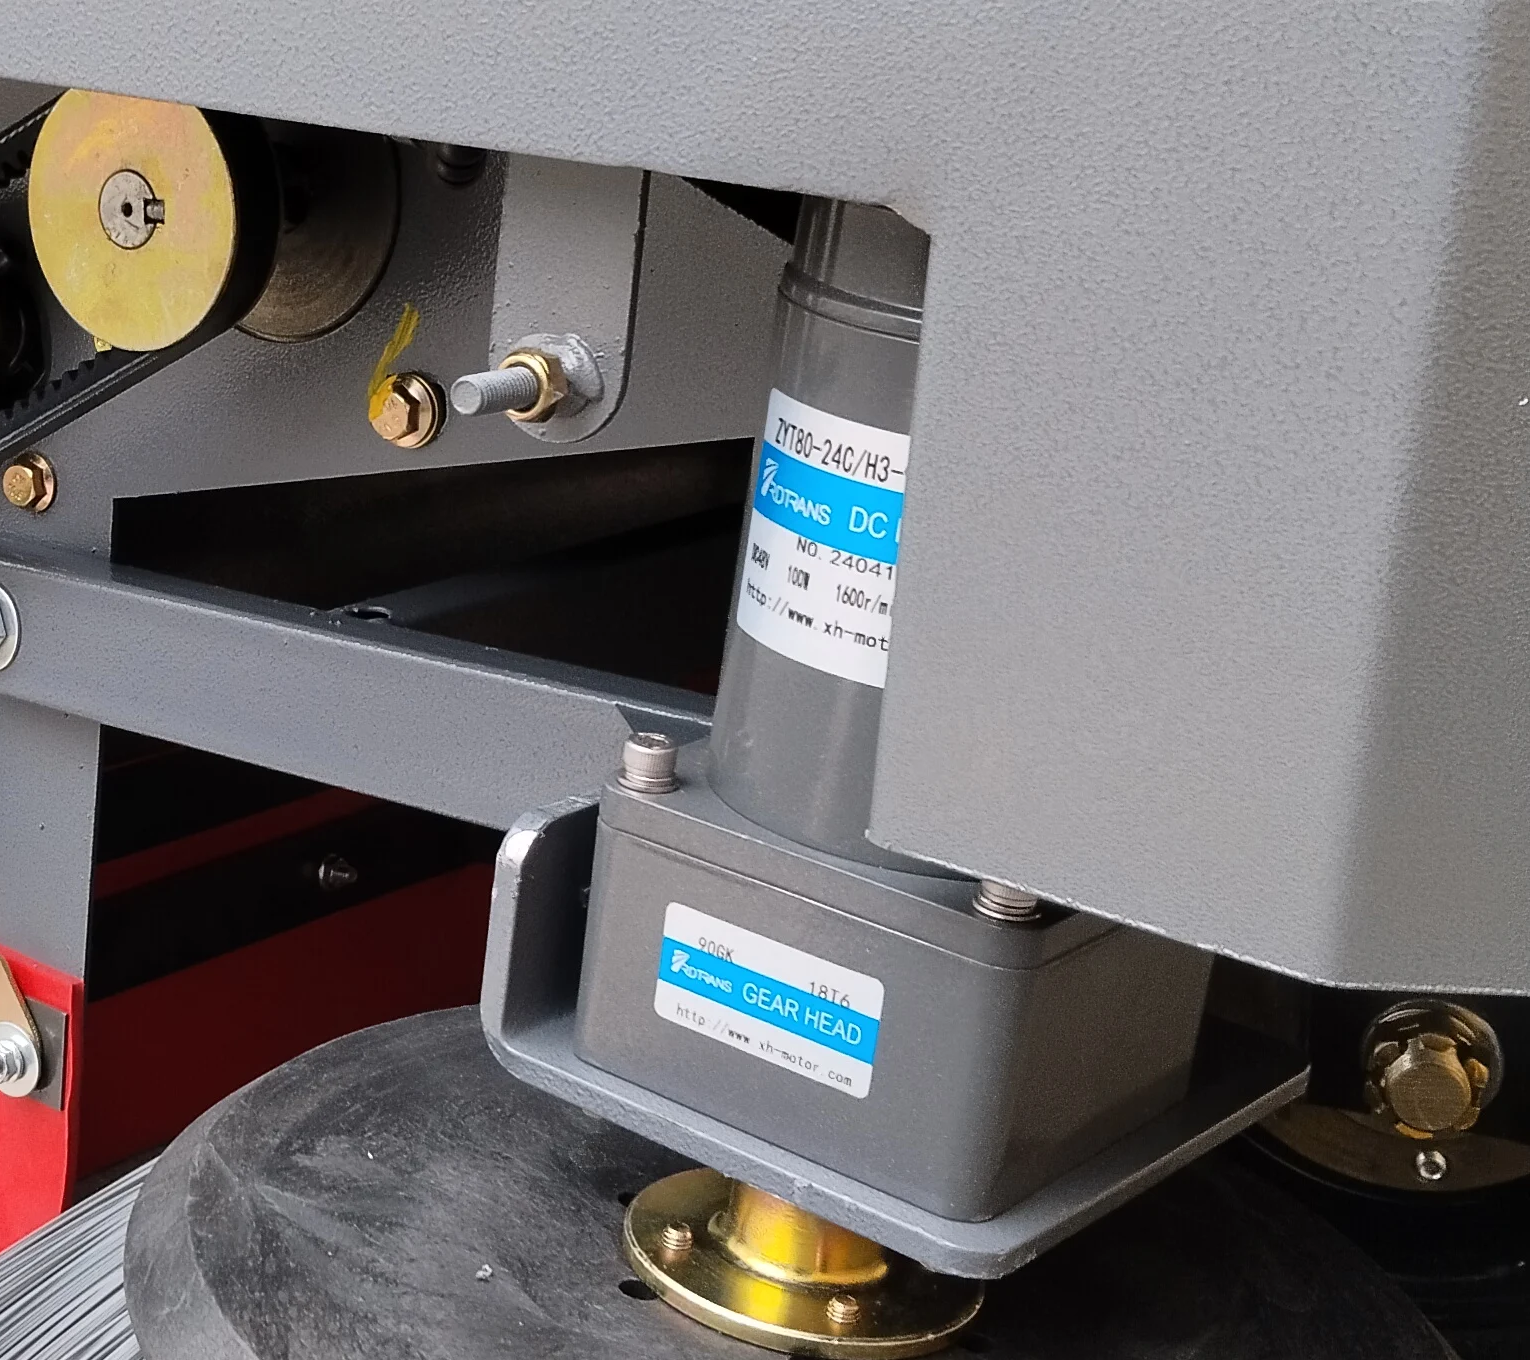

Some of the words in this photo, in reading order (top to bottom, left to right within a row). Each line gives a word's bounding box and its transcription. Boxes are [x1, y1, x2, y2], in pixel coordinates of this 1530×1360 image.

[849, 506, 889, 539] DC
[742, 982, 800, 1022] GEAR
[804, 1006, 862, 1046] HEAD
